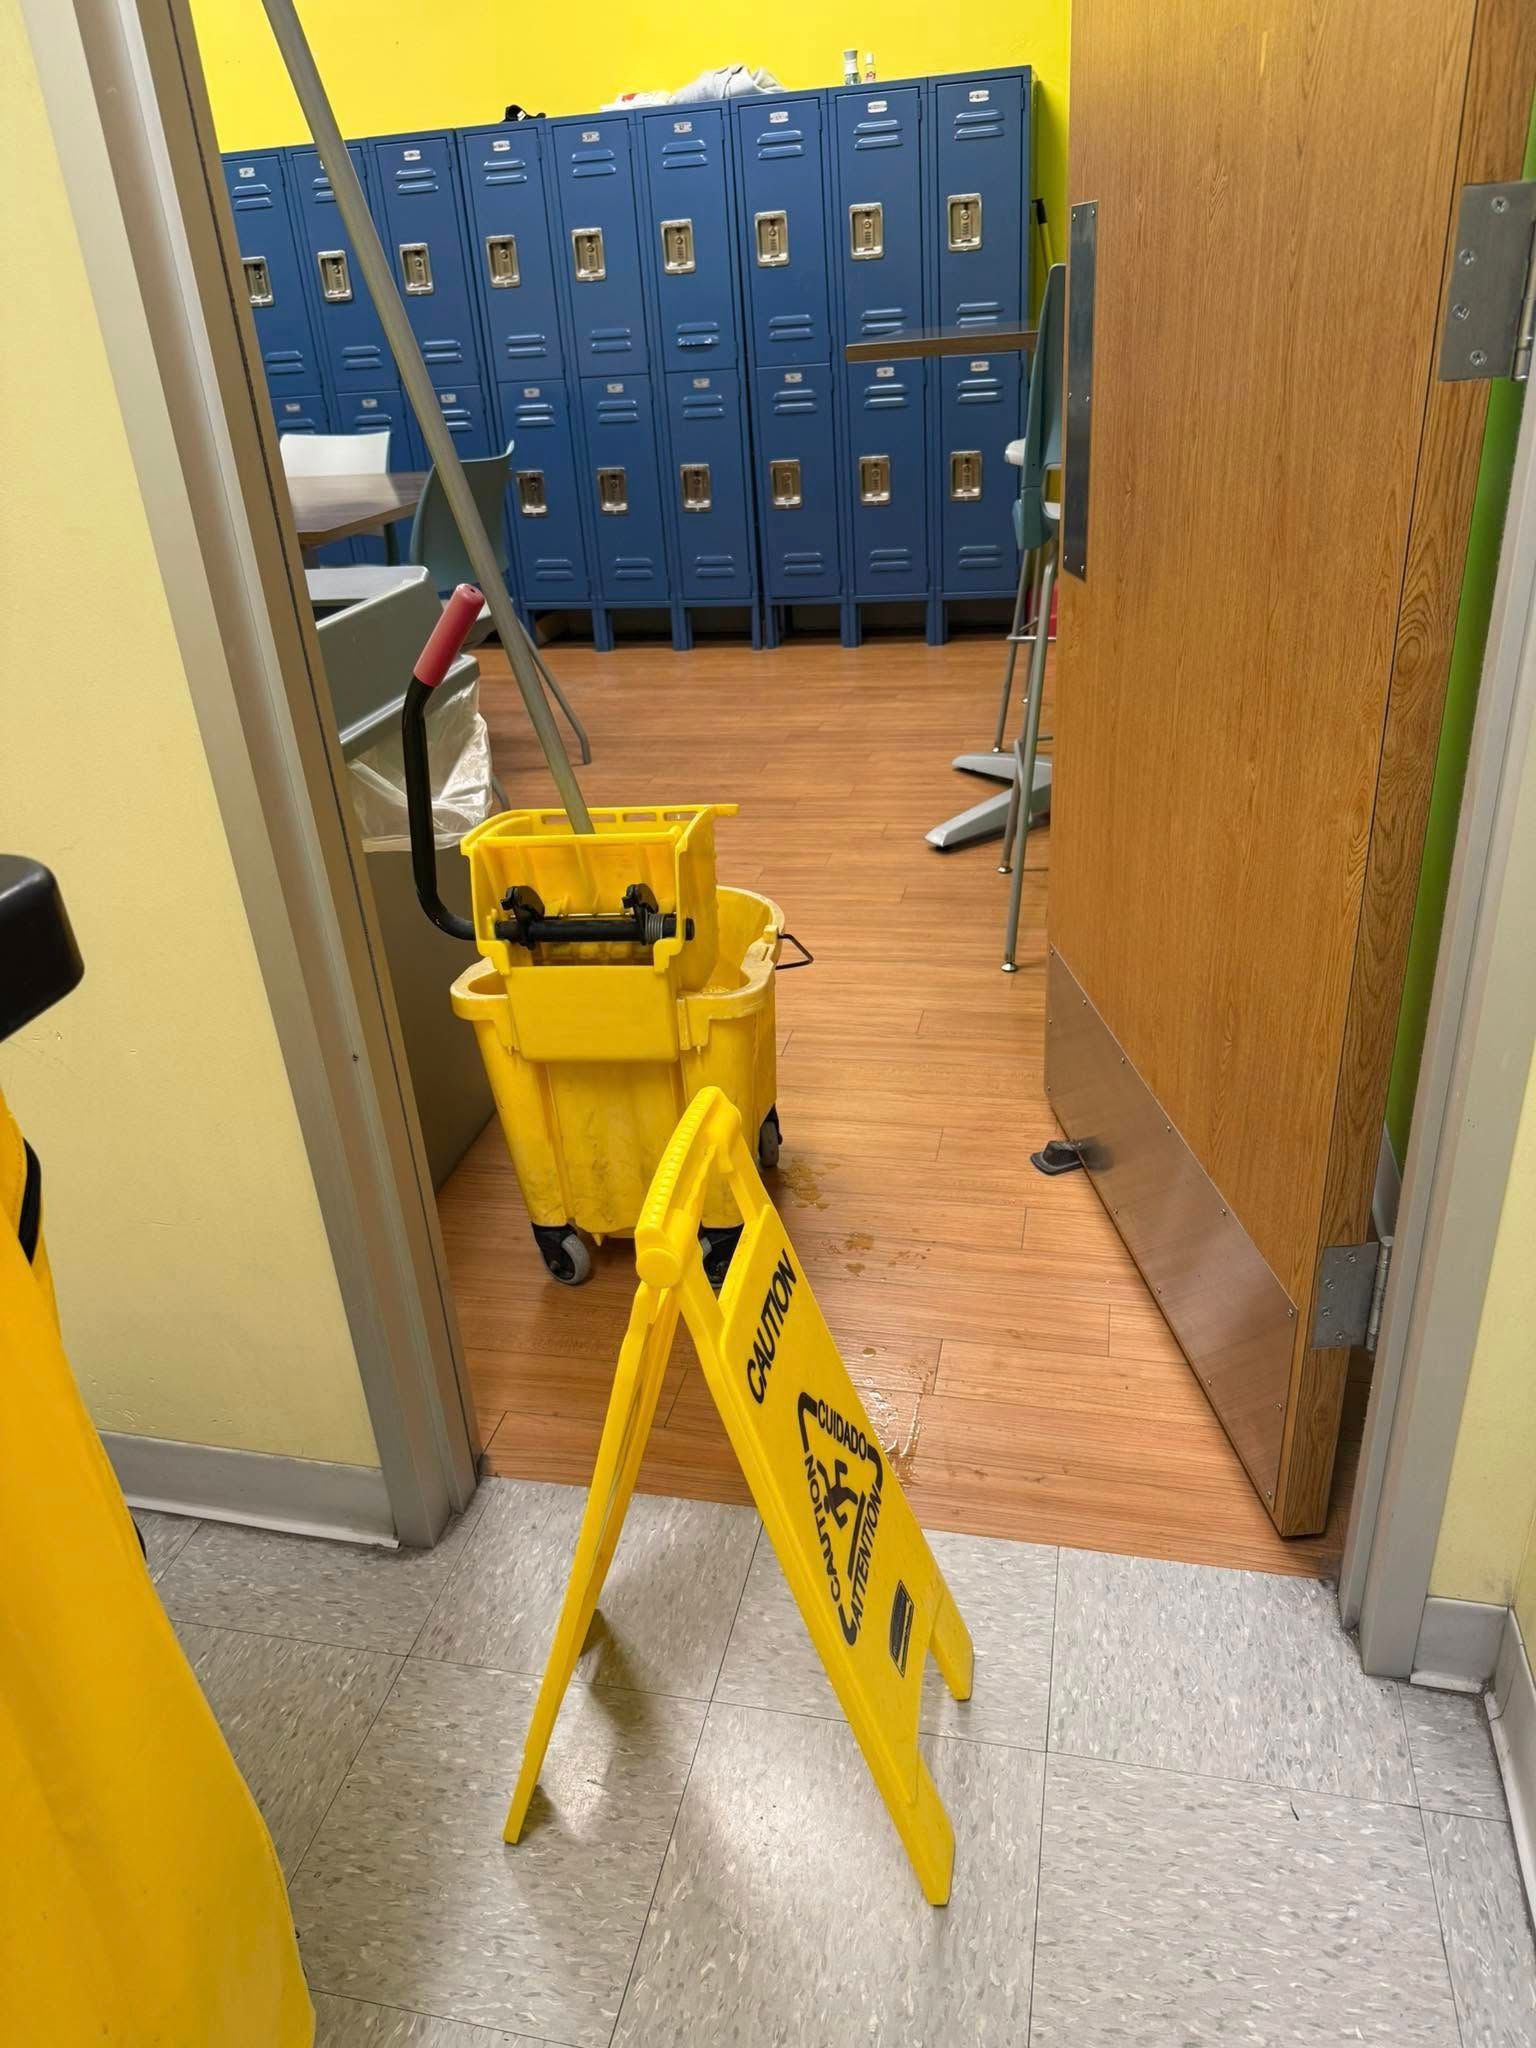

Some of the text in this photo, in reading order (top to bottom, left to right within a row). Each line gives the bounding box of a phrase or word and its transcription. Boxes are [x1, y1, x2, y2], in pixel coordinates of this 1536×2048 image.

[747, 1249, 797, 1404] CAUTION
[818, 1399, 867, 1460] CUIDADO
[805, 1455, 841, 1603] CAUTION
[851, 1483, 884, 1630] ATTENTION
